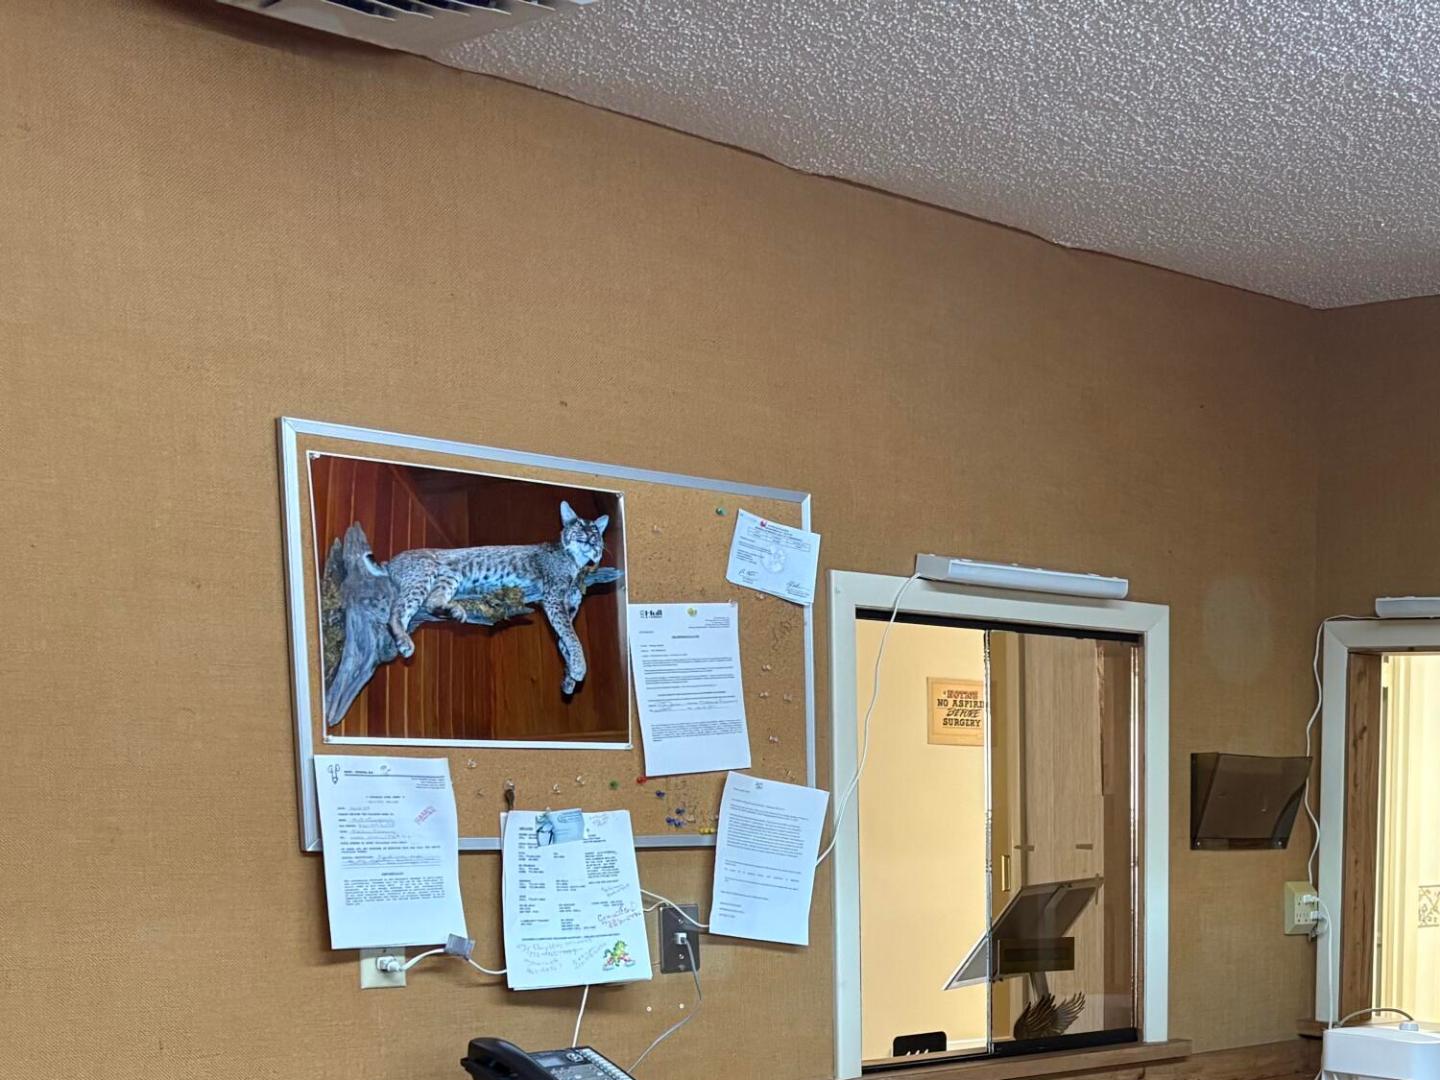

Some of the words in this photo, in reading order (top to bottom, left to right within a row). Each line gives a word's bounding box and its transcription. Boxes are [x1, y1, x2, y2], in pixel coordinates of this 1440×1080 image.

[937, 699, 949, 707] NO
[952, 700, 984, 708] ASPIRI
[943, 718, 981, 727] SURGERY
